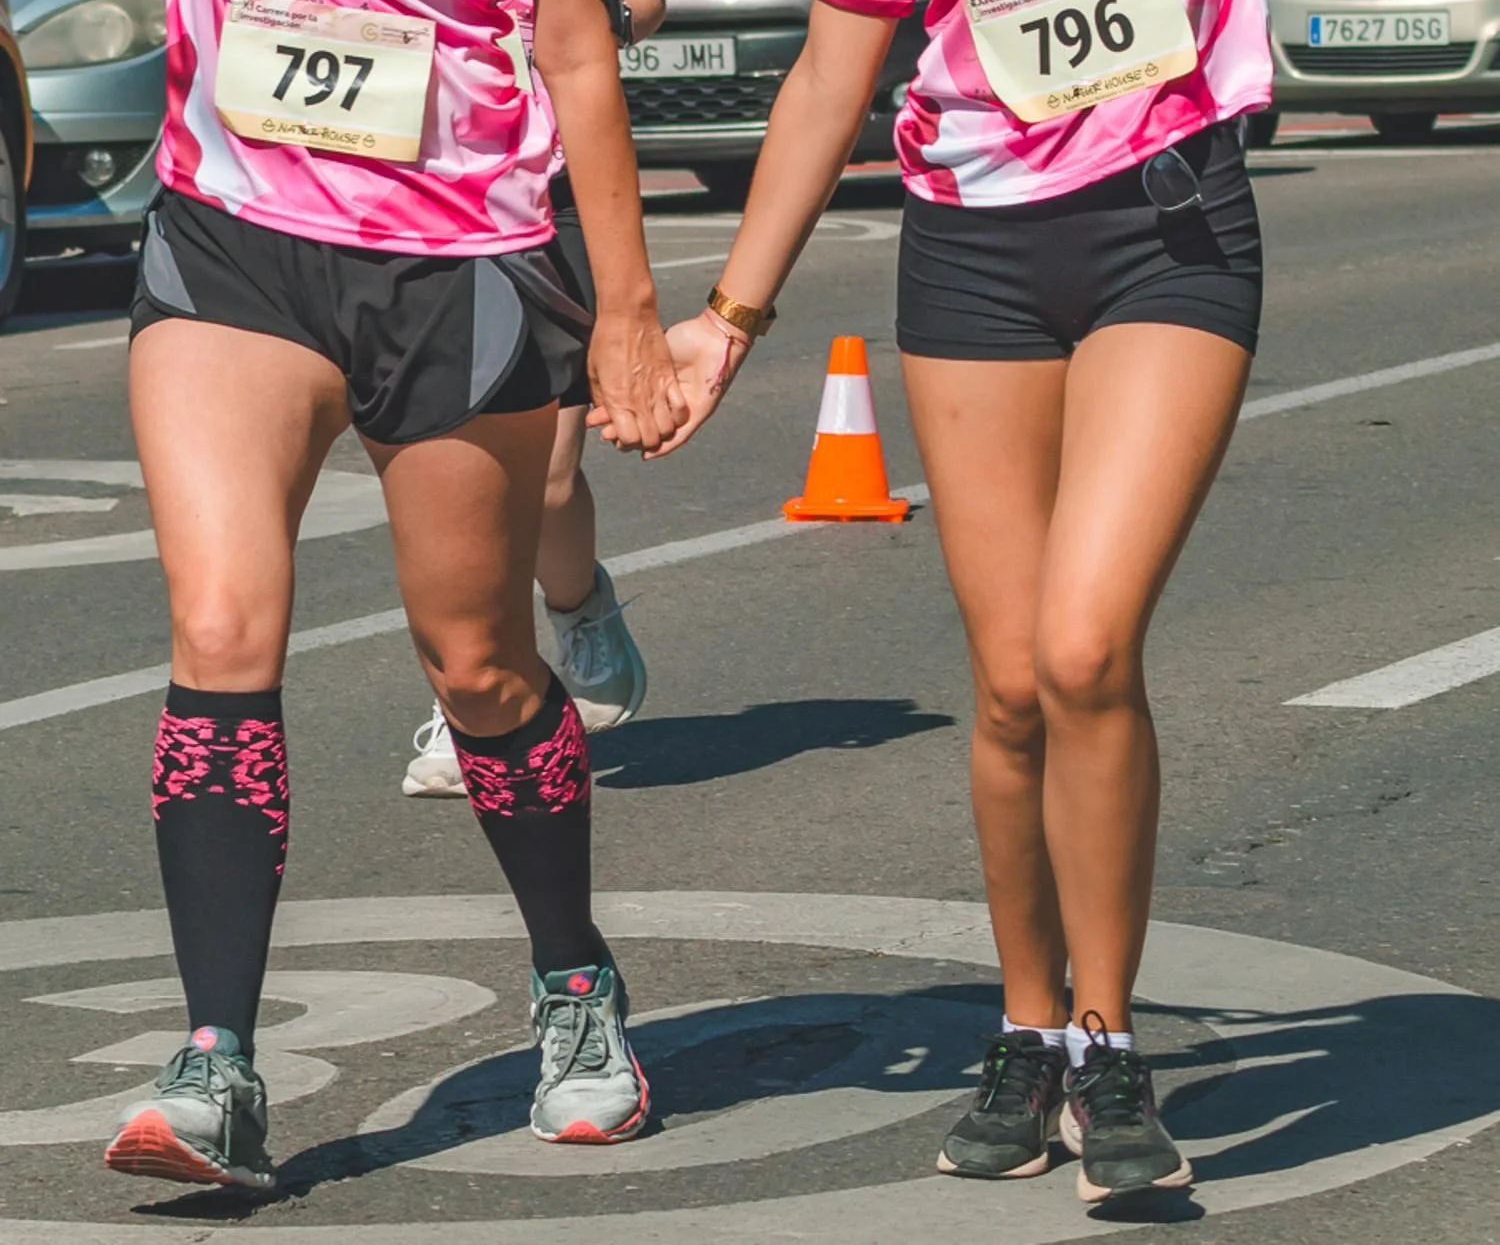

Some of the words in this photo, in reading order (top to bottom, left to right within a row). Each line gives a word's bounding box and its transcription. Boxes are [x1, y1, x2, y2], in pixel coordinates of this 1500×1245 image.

[256, 5, 290, 17] Carrera
[291, 12, 306, 21] por
[1325, 18, 1386, 42] 7627
[1395, 17, 1442, 41] DSG
[620, 45, 659, 72] 96
[672, 43, 724, 71] JMH
[272, 44, 374, 111] 797
[1103, 69, 1142, 90] HOUSE
